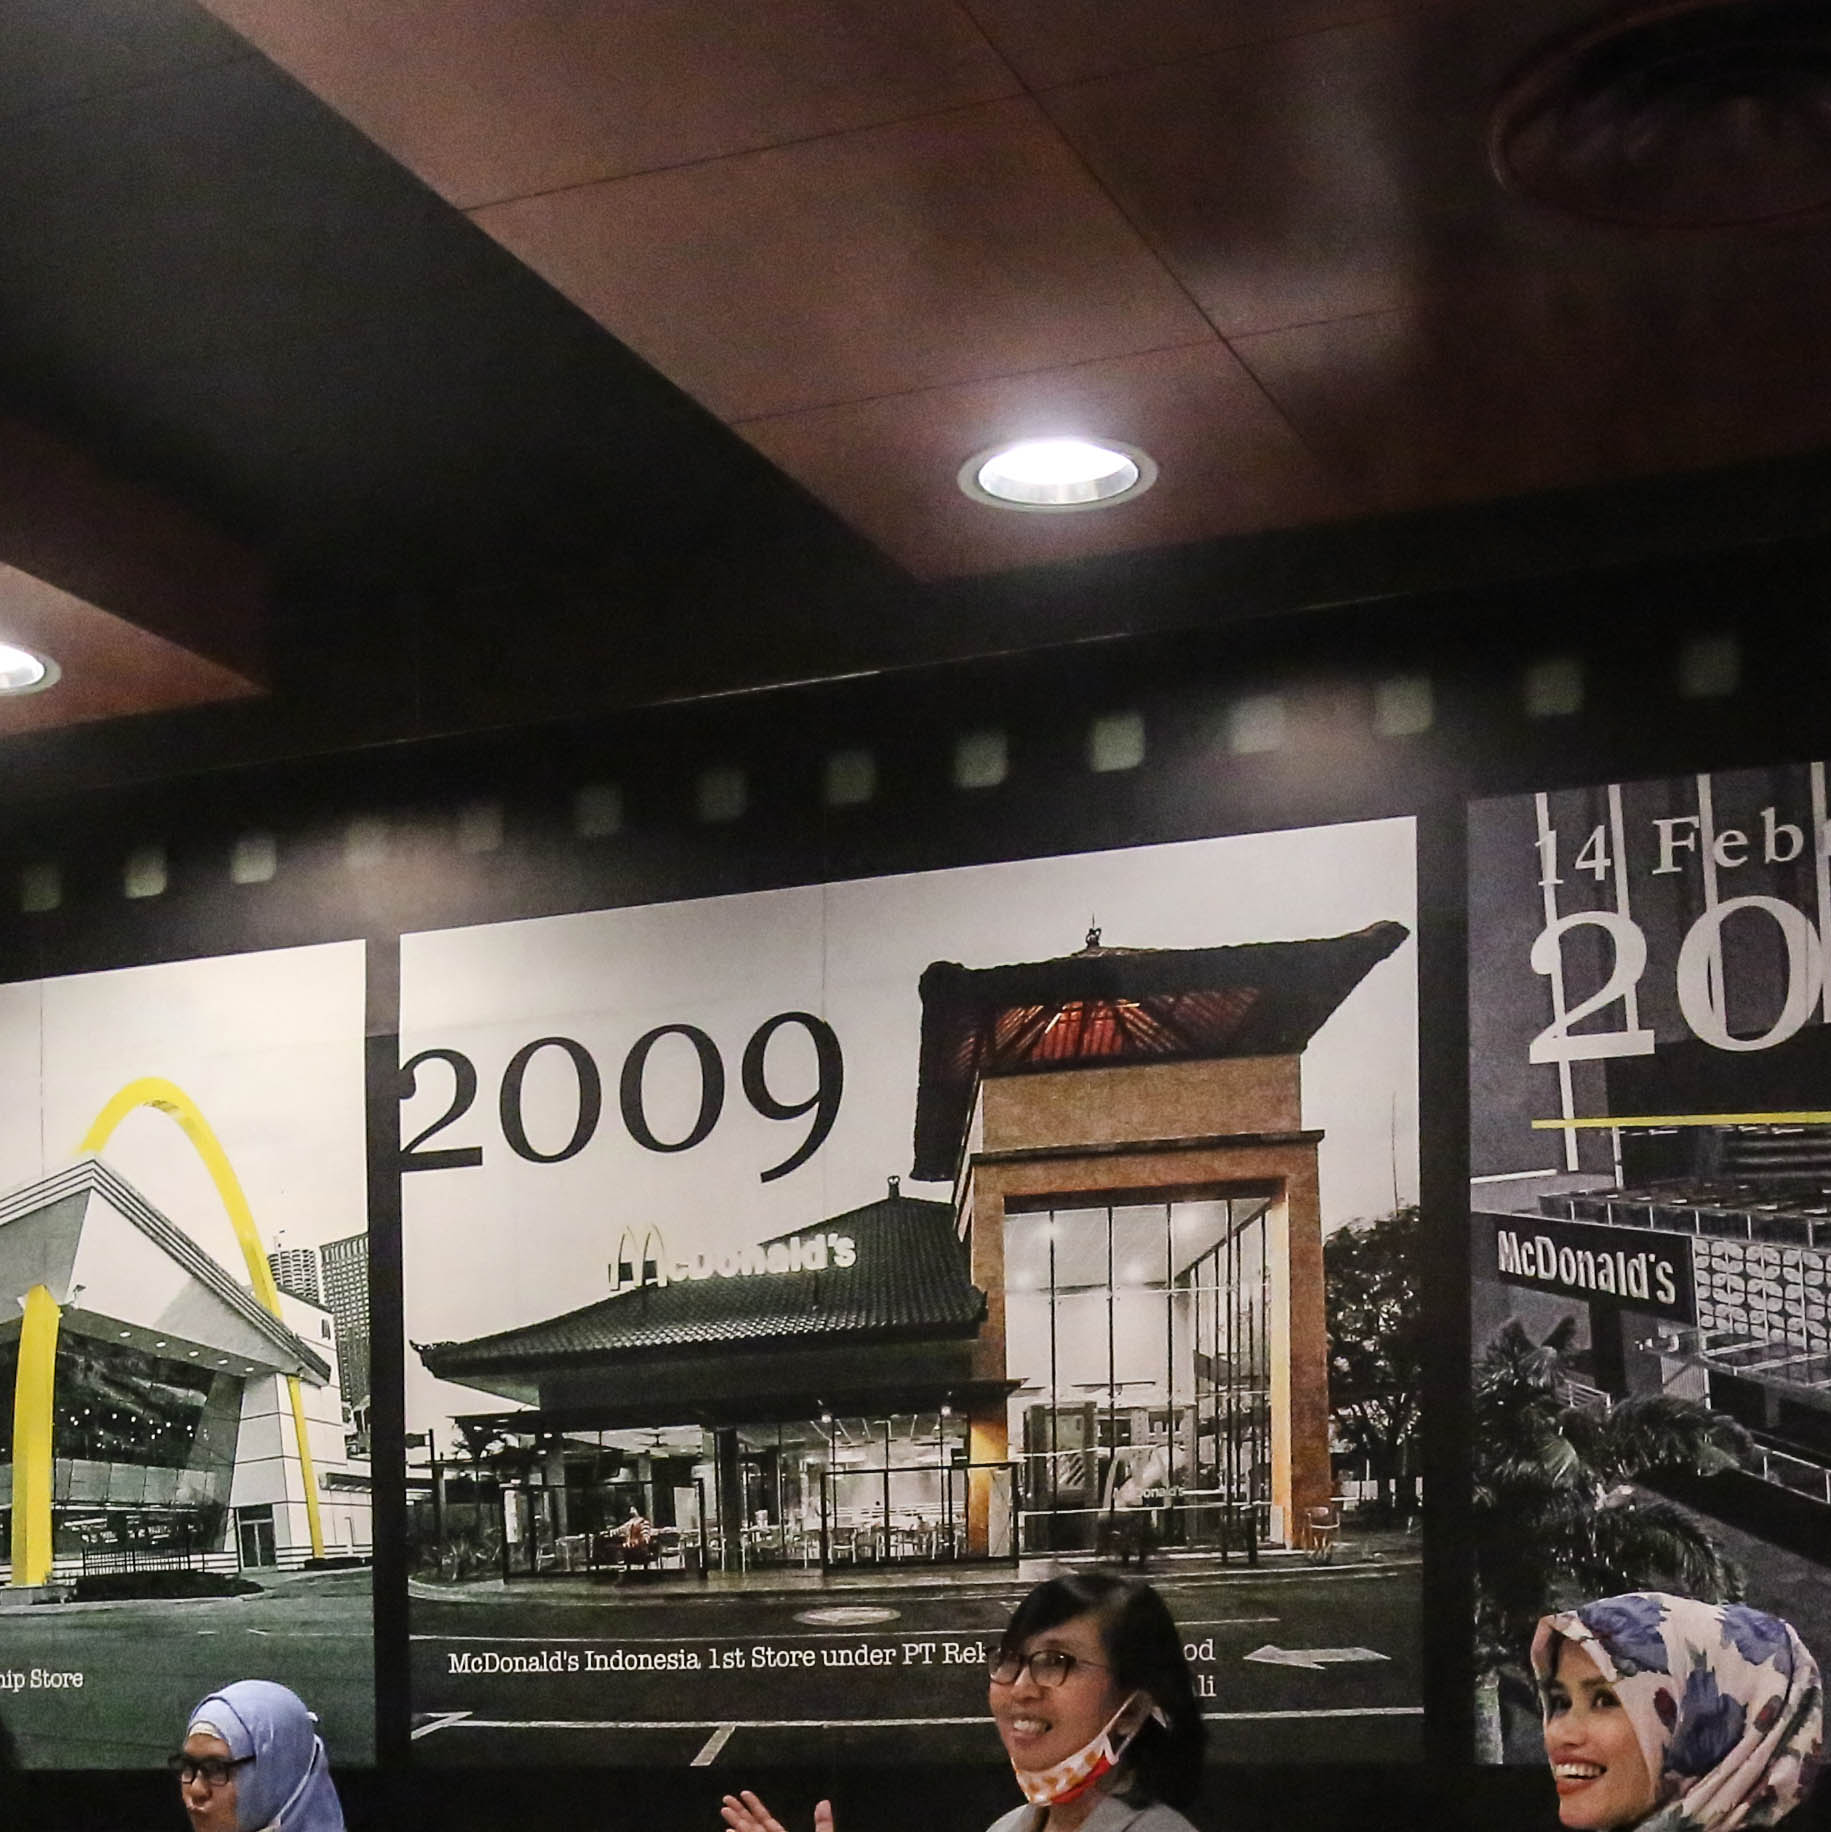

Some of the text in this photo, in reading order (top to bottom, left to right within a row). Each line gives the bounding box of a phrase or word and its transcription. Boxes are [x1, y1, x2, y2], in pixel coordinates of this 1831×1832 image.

[1535, 824, 1611, 886] 14
[398, 1011, 845, 1183] 2009
[607, 1223, 857, 1291] McDonald's
[1497, 1230, 1676, 1304] McDonald's
[30, 1668, 84, 1688] Store
[447, 1652, 580, 1674] McDonald's
[584, 1649, 700, 1672] Indonesia
[709, 1647, 745, 1669] 1st
[751, 1646, 816, 1669] Store
[823, 1644, 896, 1667] under
[901, 1643, 936, 1665] PT
